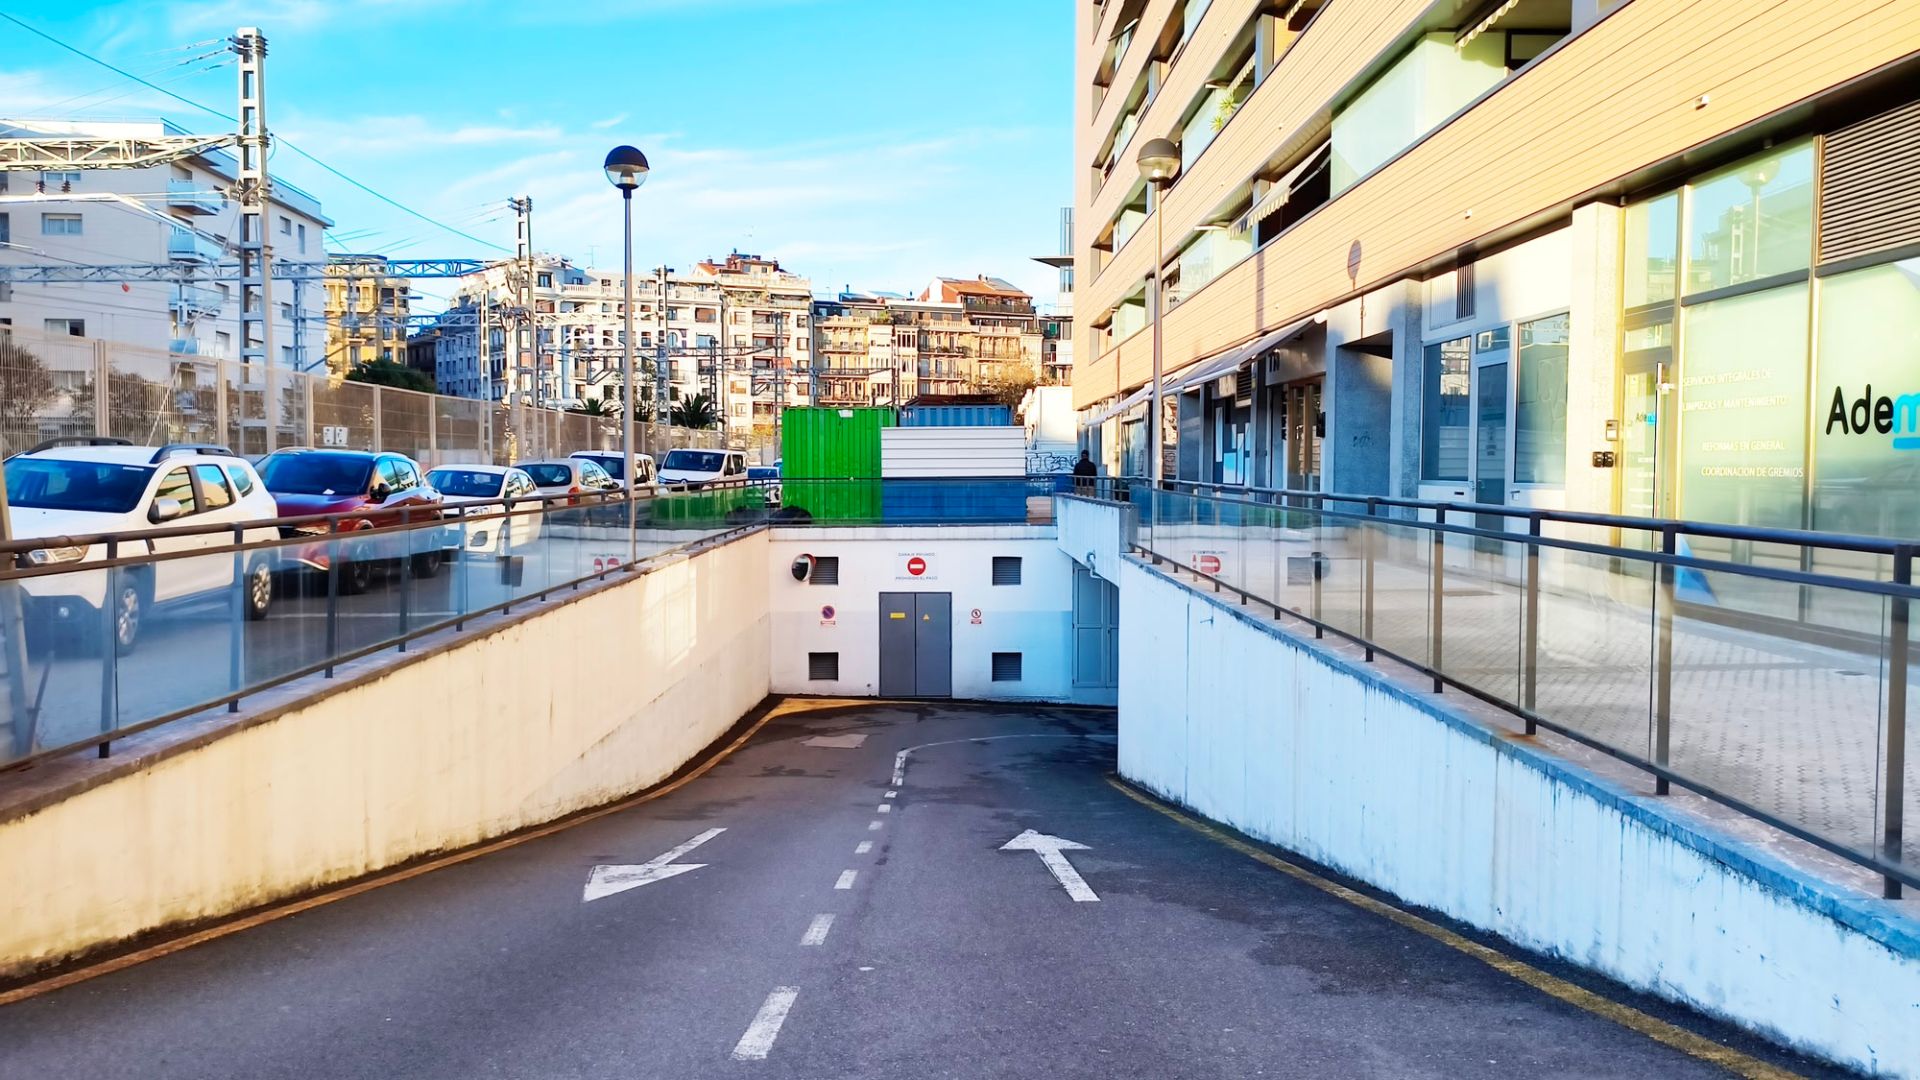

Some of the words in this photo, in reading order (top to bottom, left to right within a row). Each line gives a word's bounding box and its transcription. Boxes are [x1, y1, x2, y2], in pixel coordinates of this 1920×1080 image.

[1683, 374, 1715, 386] SERVICIOS
[1716, 369, 1759, 384] INTEGRALES
[1702, 441, 1738, 451] REFORMAS
[1739, 441, 1750, 451] EN
[1751, 440, 1785, 450] GENERAL
[1755, 467, 1767, 477] DE
[1768, 467, 1804, 477] GREMIOS
